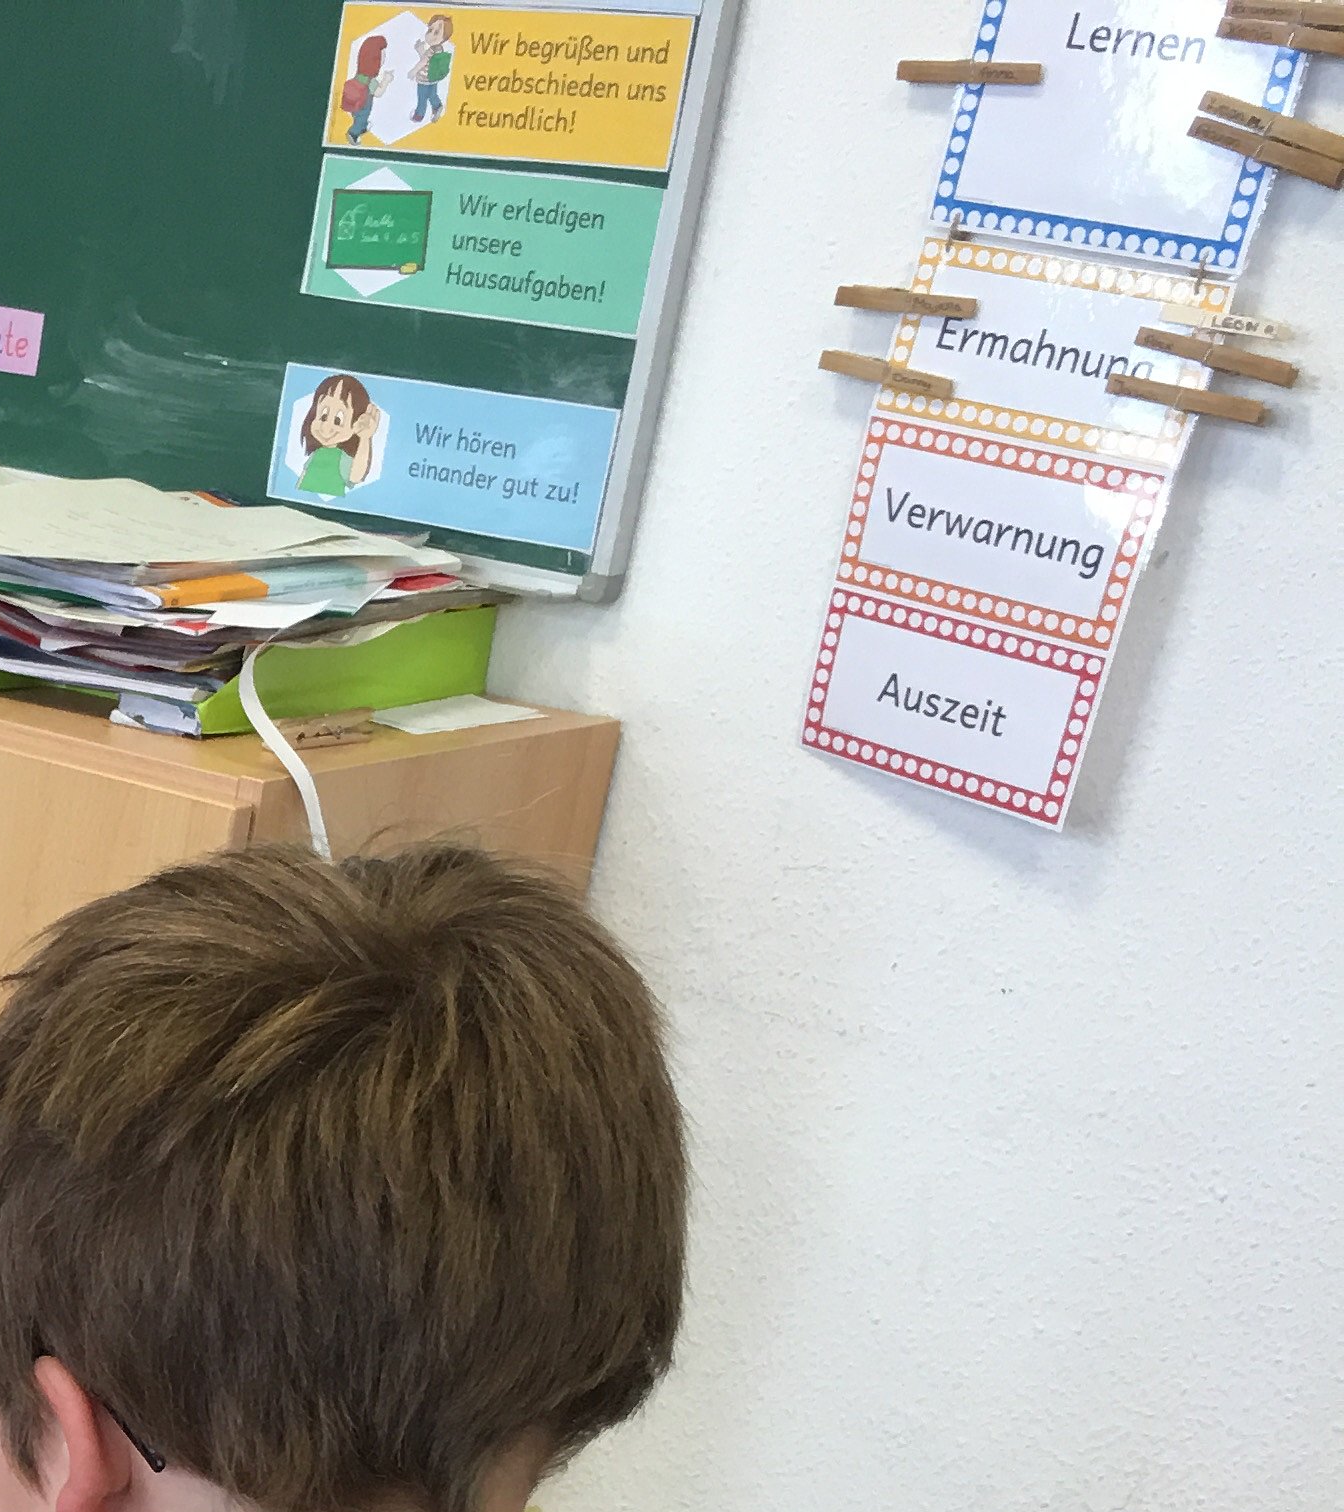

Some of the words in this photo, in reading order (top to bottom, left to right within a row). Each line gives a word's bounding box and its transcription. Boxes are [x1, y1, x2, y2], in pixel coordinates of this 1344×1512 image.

[470, 32, 509, 56] Wir
[515, 33, 618, 66] begrüßen
[626, 40, 670, 64] und
[1066, 12, 1206, 64] Lernen
[463, 69, 619, 99] verabschieden
[627, 83, 667, 102] uns
[457, 102, 576, 134] freundlich!
[459, 193, 497, 217] Wir
[503, 199, 605, 233] erledigen
[452, 233, 523, 257] unsere
[445, 262, 606, 303] Hausaufgaben!
[415, 422, 452, 448] Wir
[456, 428, 516, 459] hören
[408, 458, 497, 490] einander
[502, 478, 539, 499] gut
[545, 482, 580, 504] zu!
[885, 487, 1105, 580] Verwarnung
[876, 672, 1007, 737] Auszeit
